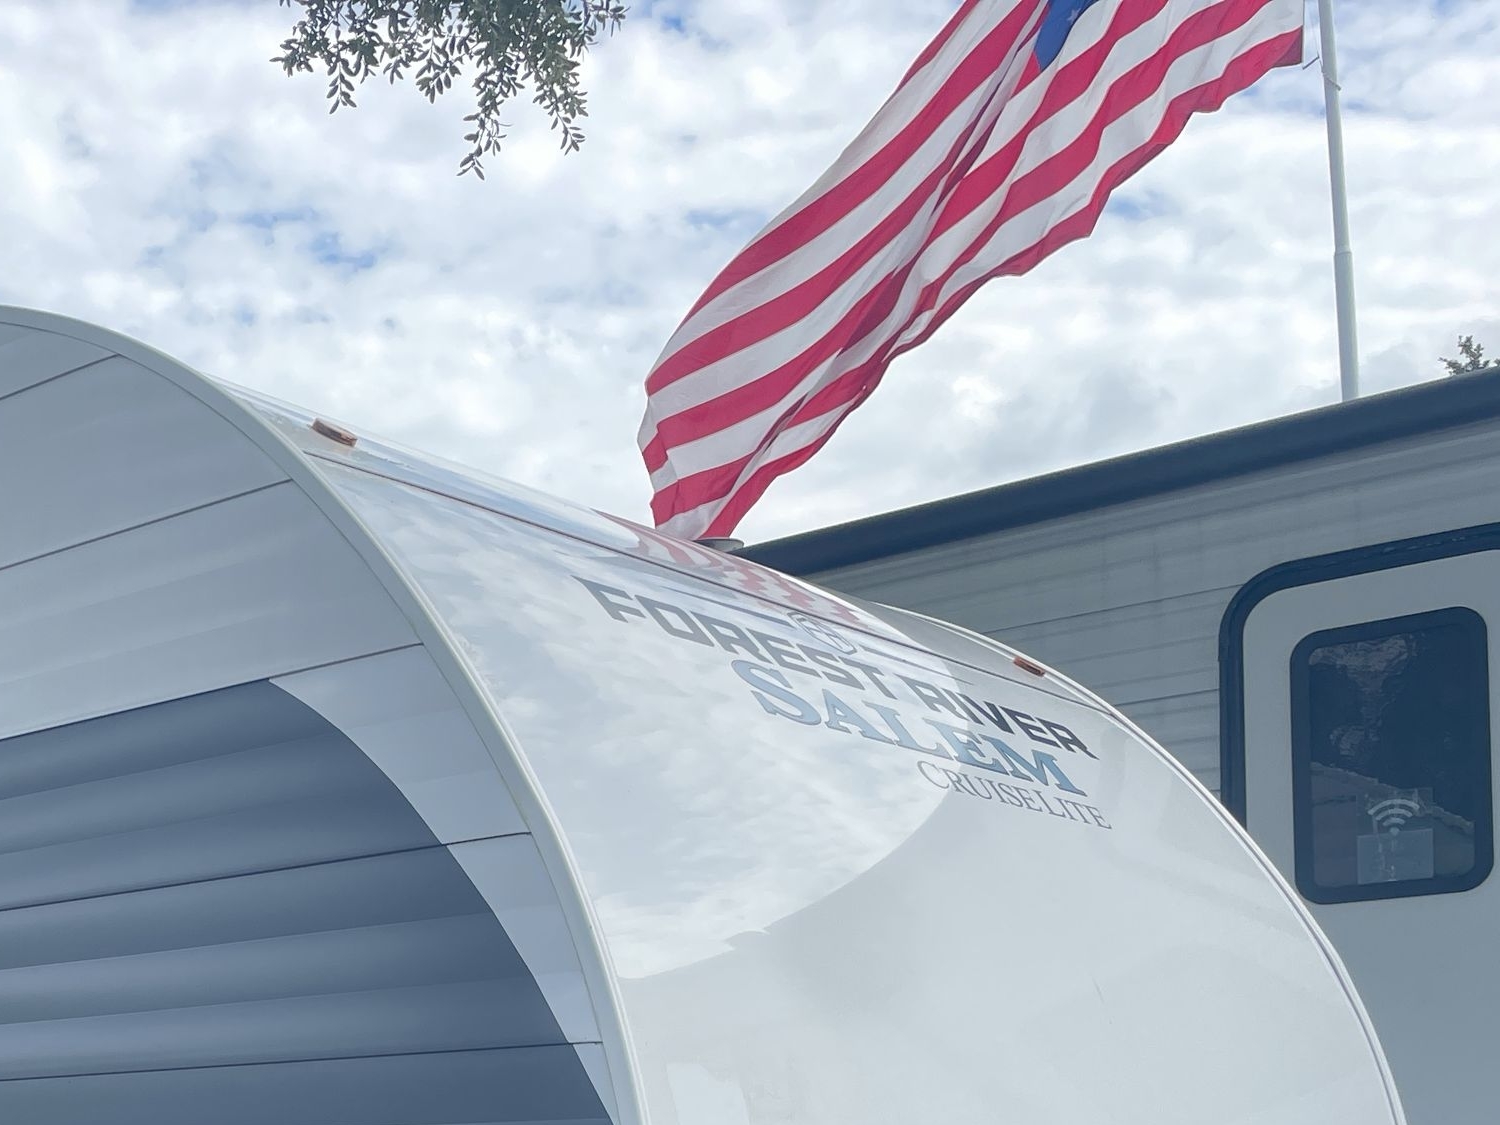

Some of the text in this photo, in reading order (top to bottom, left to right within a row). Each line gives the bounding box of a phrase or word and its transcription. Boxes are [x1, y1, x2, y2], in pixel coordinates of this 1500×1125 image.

[572, 575, 1099, 760] FOREST RIVER
[730, 659, 1087, 796] SALEM
